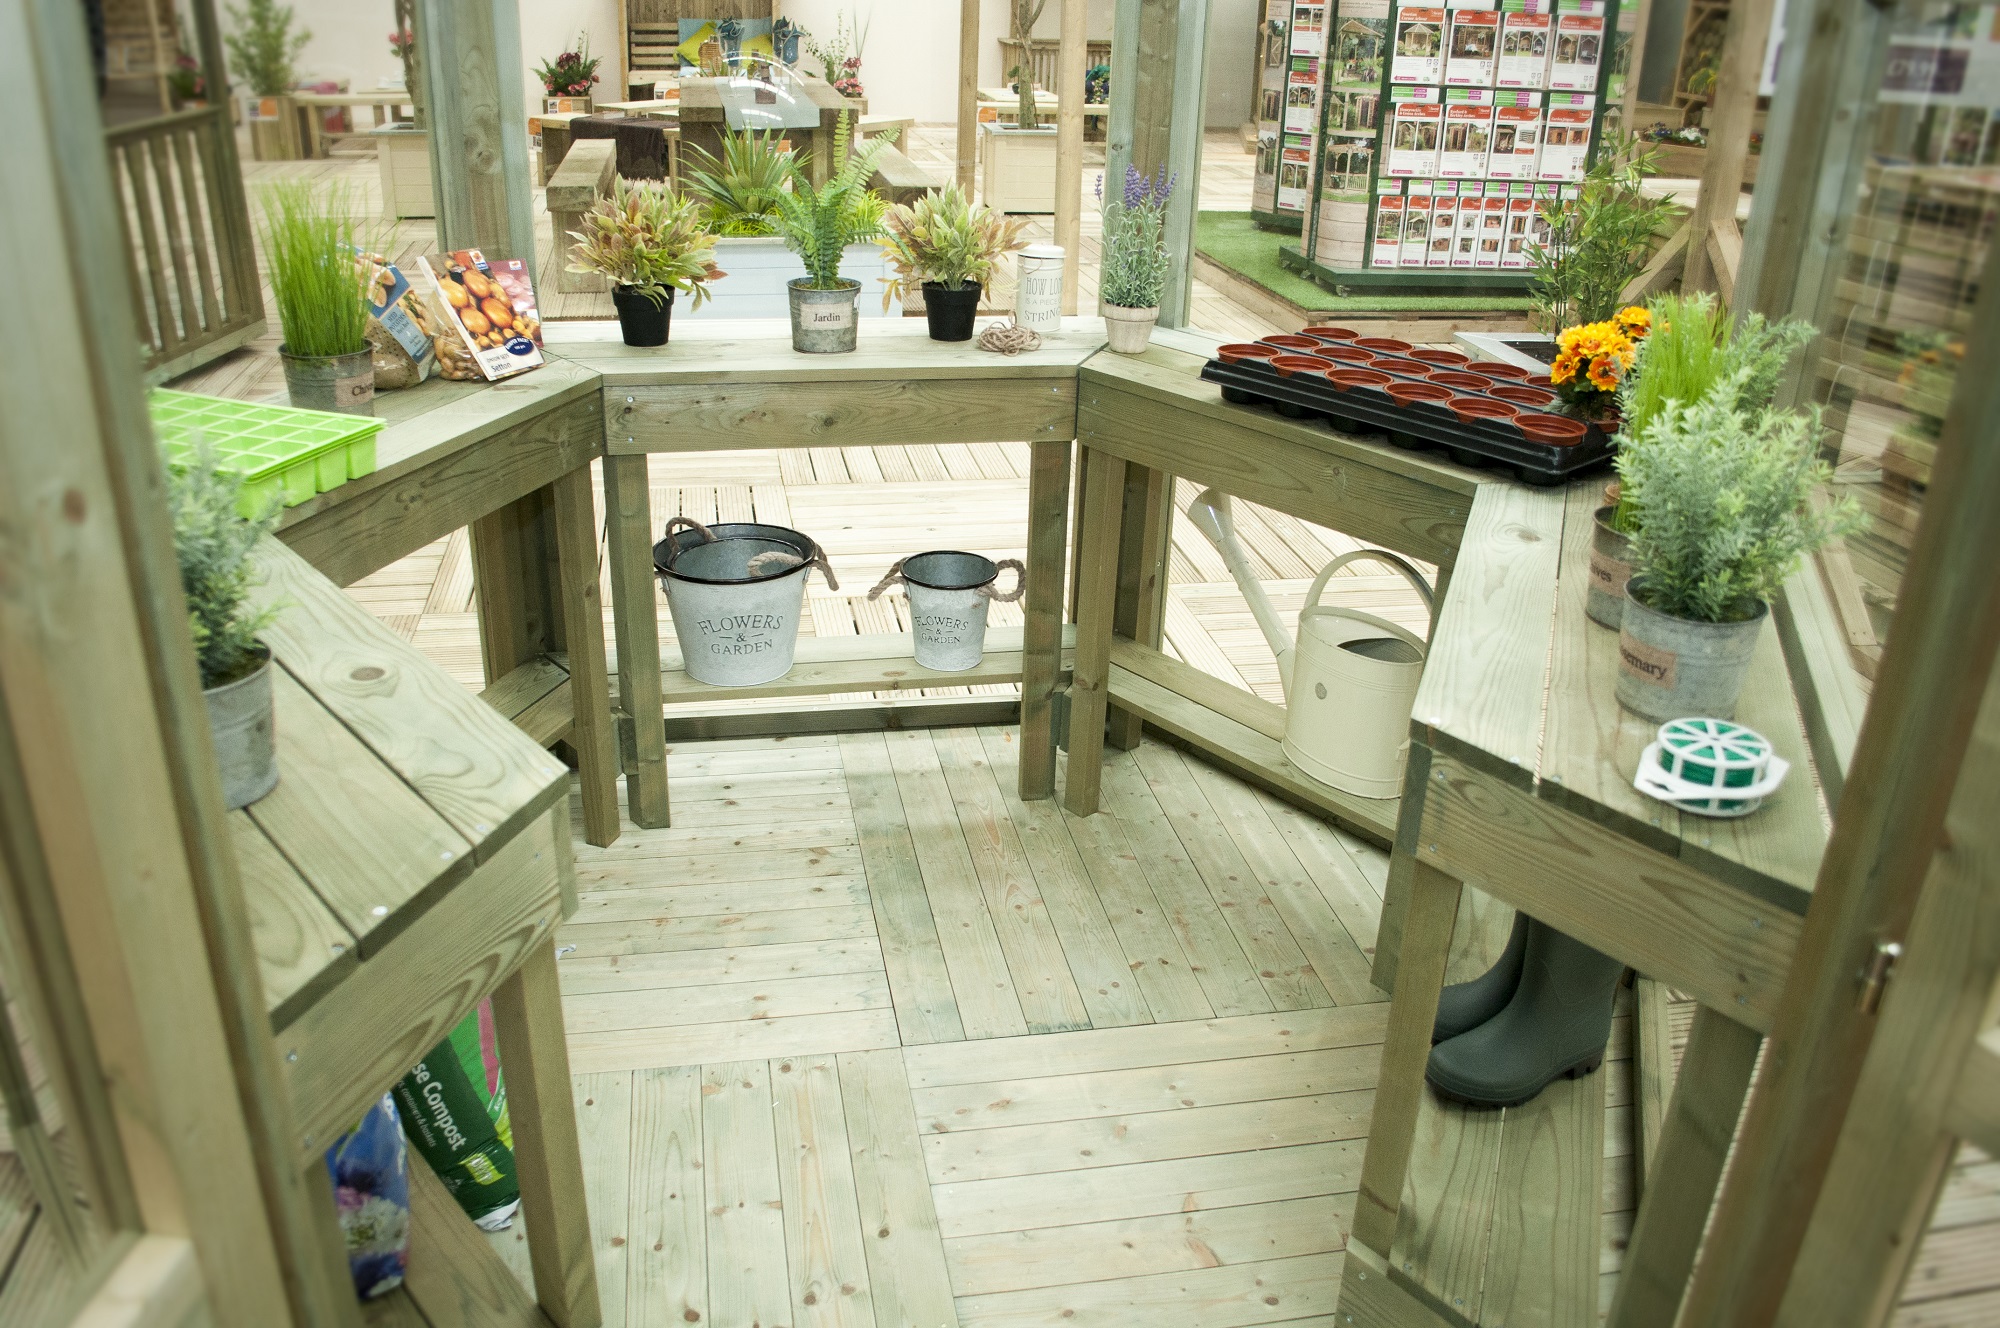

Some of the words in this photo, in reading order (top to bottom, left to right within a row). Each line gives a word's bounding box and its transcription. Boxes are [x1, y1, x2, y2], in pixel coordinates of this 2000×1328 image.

[1026, 277, 1047, 296] HOW
[813, 313, 841, 322] Jardin
[697, 614, 784, 635] FLOWERS
[914, 615, 969, 631] FLOWERS
[736, 633, 747, 643] &
[921, 632, 961, 644] GARDEN
[711, 639, 773, 656] GARDEN
[422, 1081, 467, 1151] Compost
